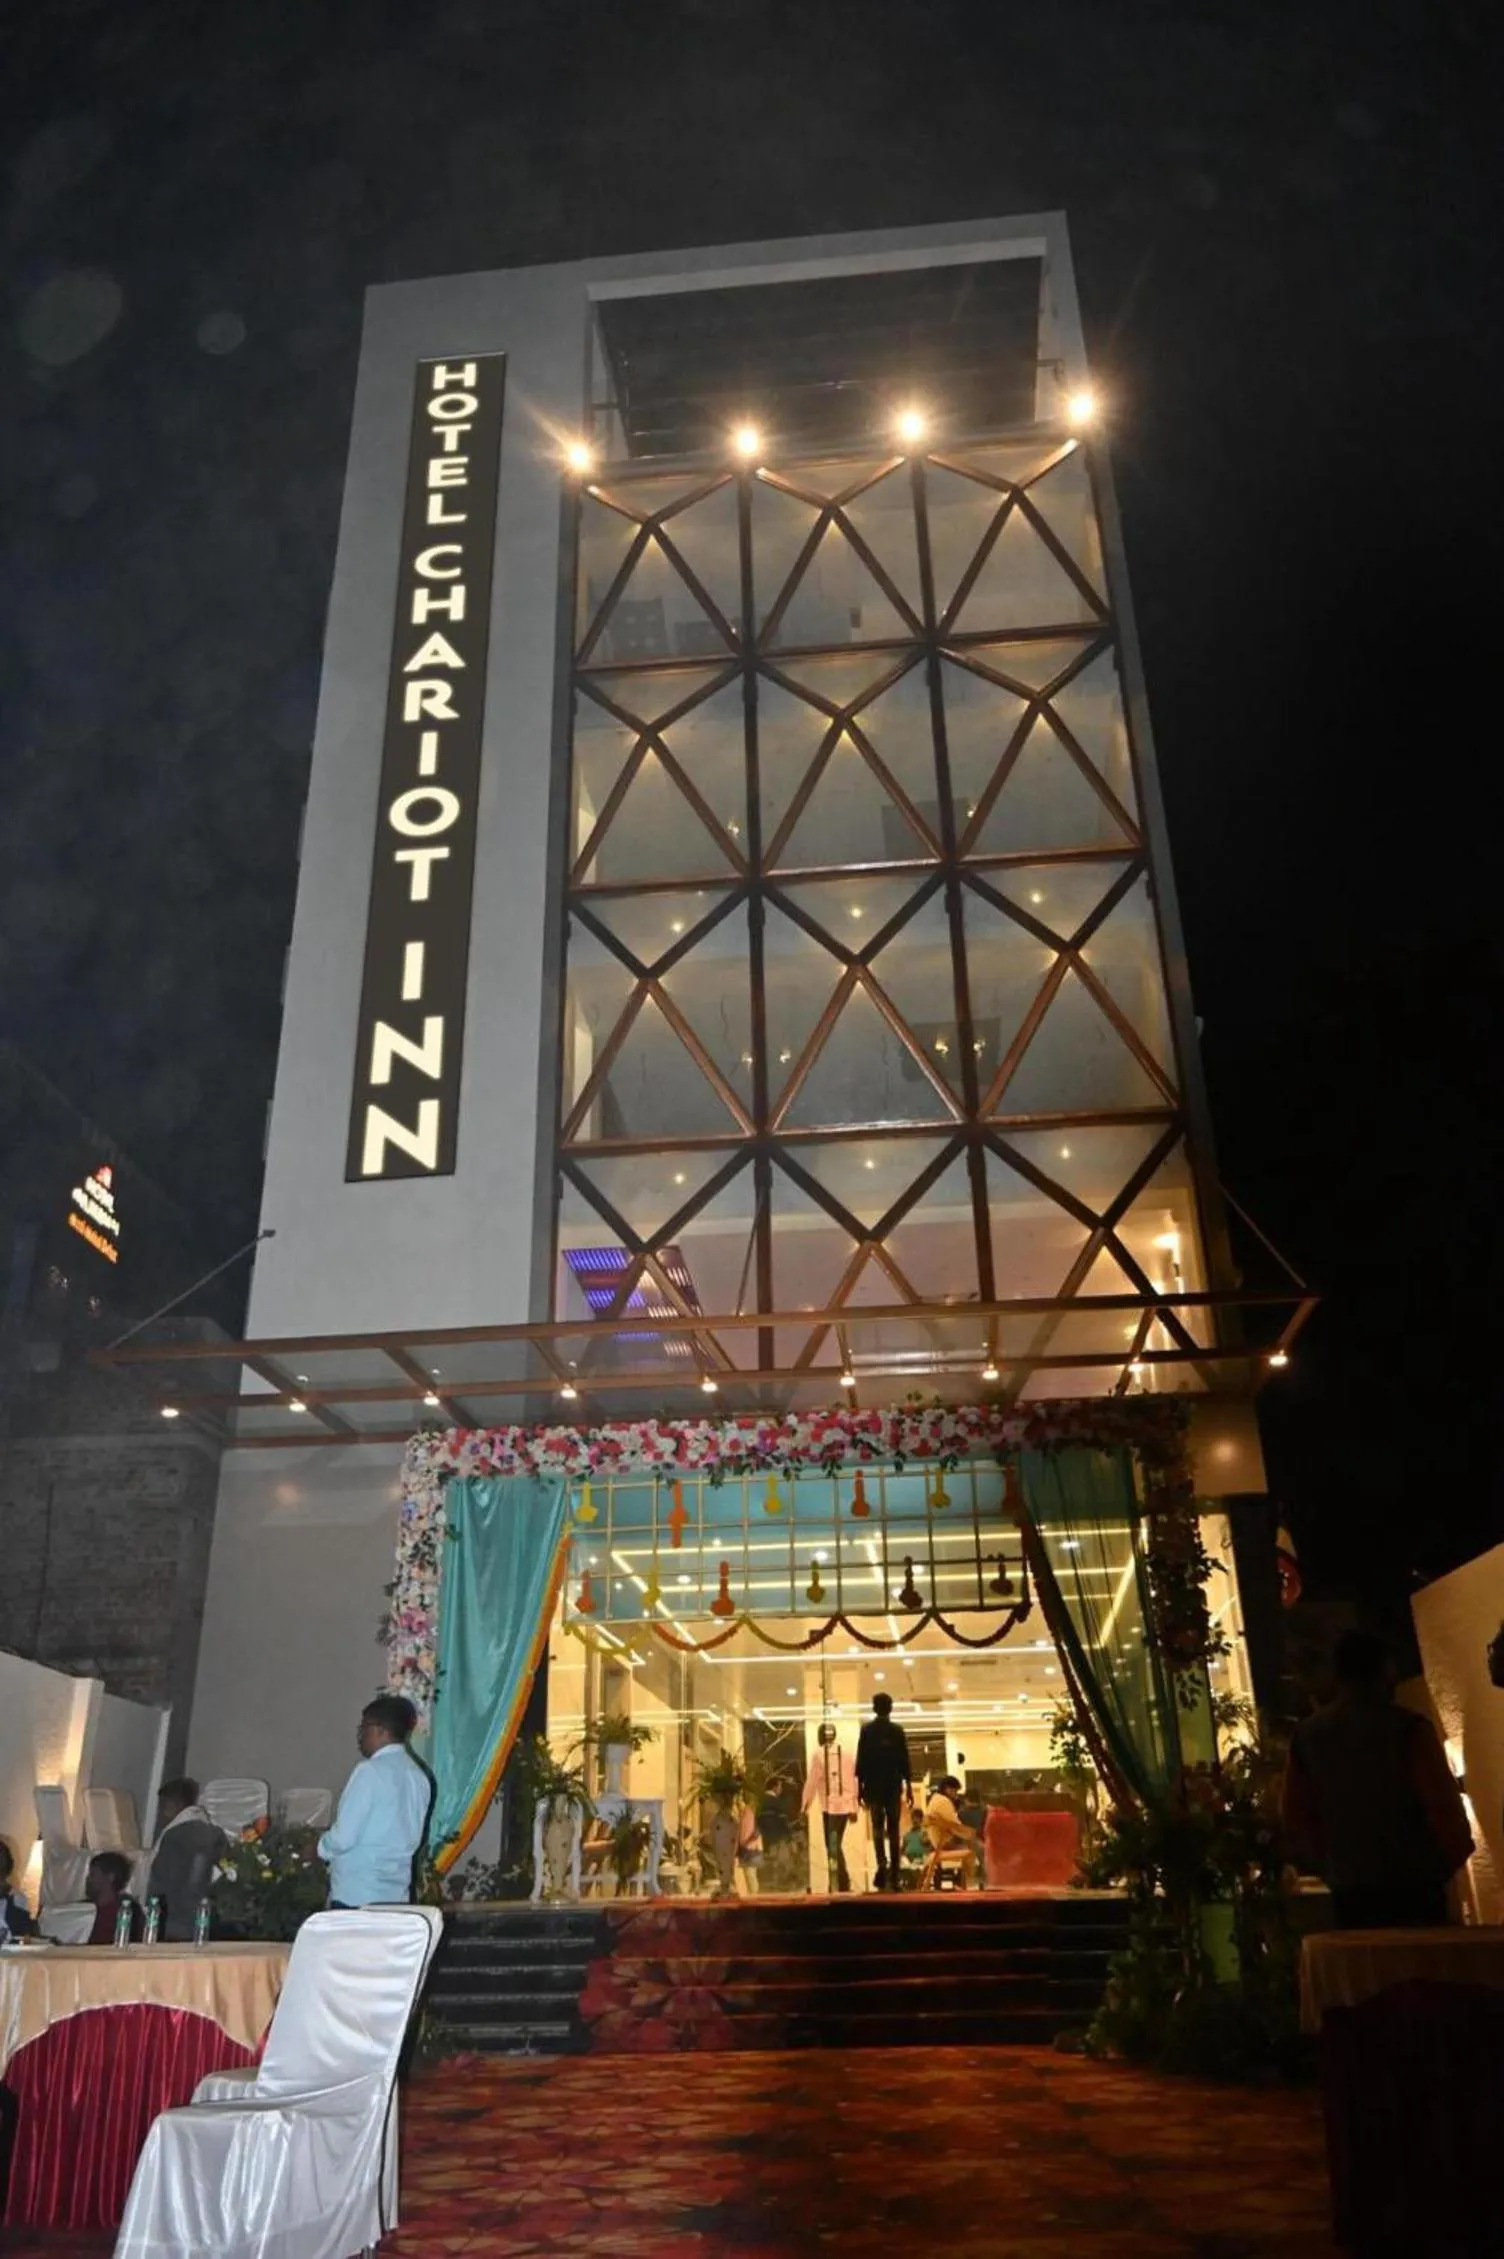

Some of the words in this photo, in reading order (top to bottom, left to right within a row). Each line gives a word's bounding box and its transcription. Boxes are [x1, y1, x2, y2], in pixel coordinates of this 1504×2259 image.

[427, 362, 479, 525] HOTEL
[389, 544, 466, 901] CHARIOT
[362, 941, 444, 1175] INN
